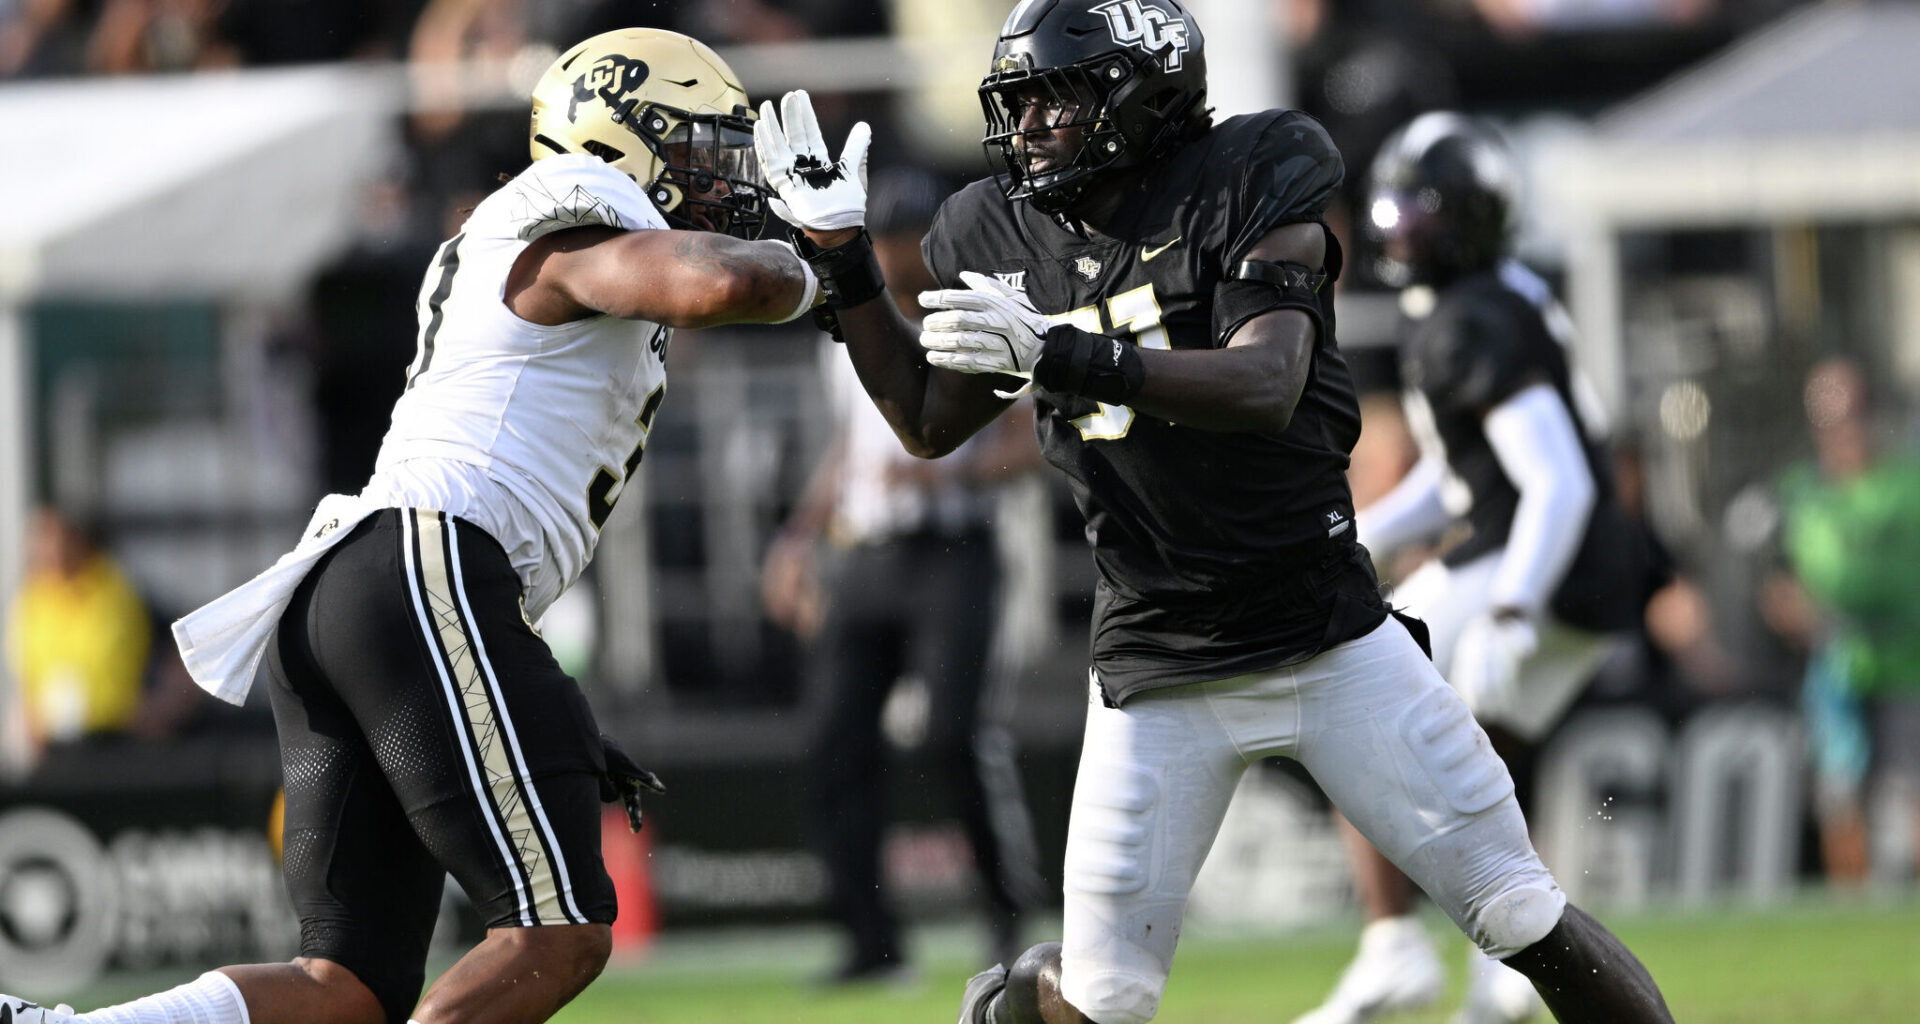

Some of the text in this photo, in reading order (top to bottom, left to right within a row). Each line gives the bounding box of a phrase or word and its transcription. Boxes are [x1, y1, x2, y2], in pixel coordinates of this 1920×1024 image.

[1090, 0, 1189, 73] UCF
[583, 58, 626, 95] CU
[1075, 256, 1101, 280] UCF
[993, 270, 1026, 291] XII
[1327, 510, 1344, 524] XL
